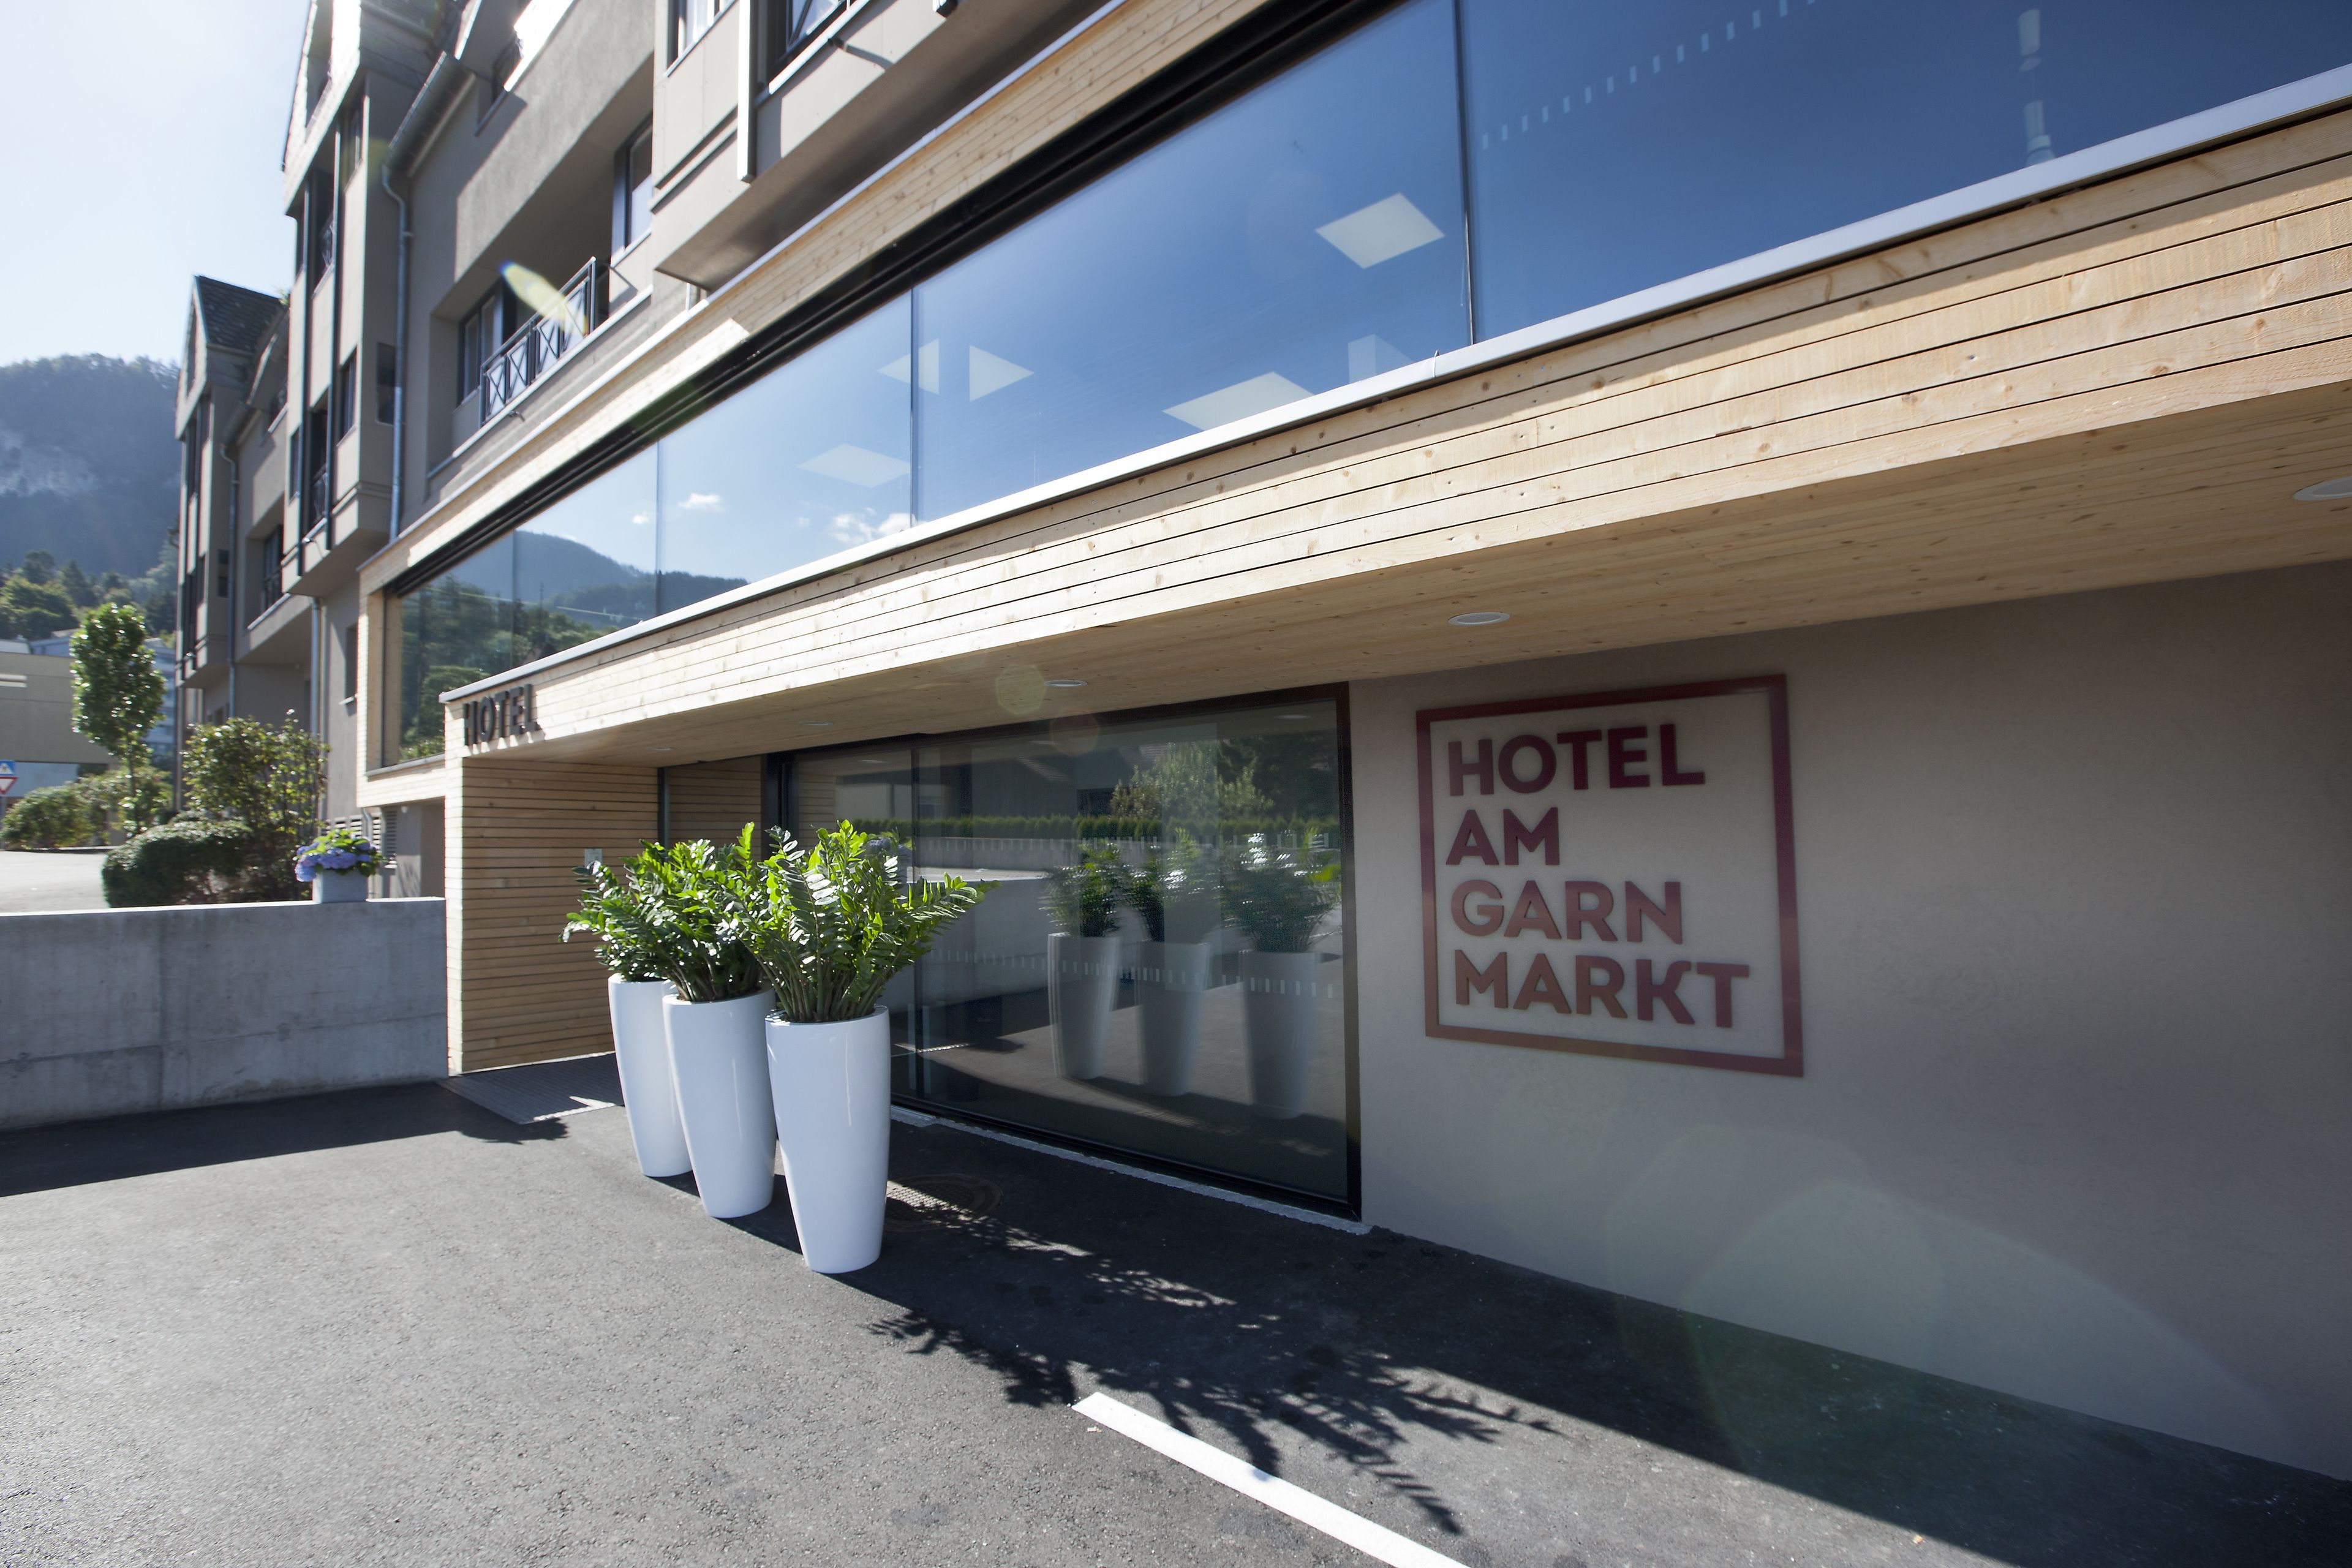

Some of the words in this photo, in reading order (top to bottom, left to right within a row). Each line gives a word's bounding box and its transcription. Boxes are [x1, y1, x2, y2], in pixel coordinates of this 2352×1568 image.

[464, 684, 541, 746] HOTEL
[1447, 723, 1706, 797] HOTEL
[1446, 807, 1561, 866] AM
[1450, 879, 1683, 944] GARN
[1455, 949, 1750, 1028] MARKT
